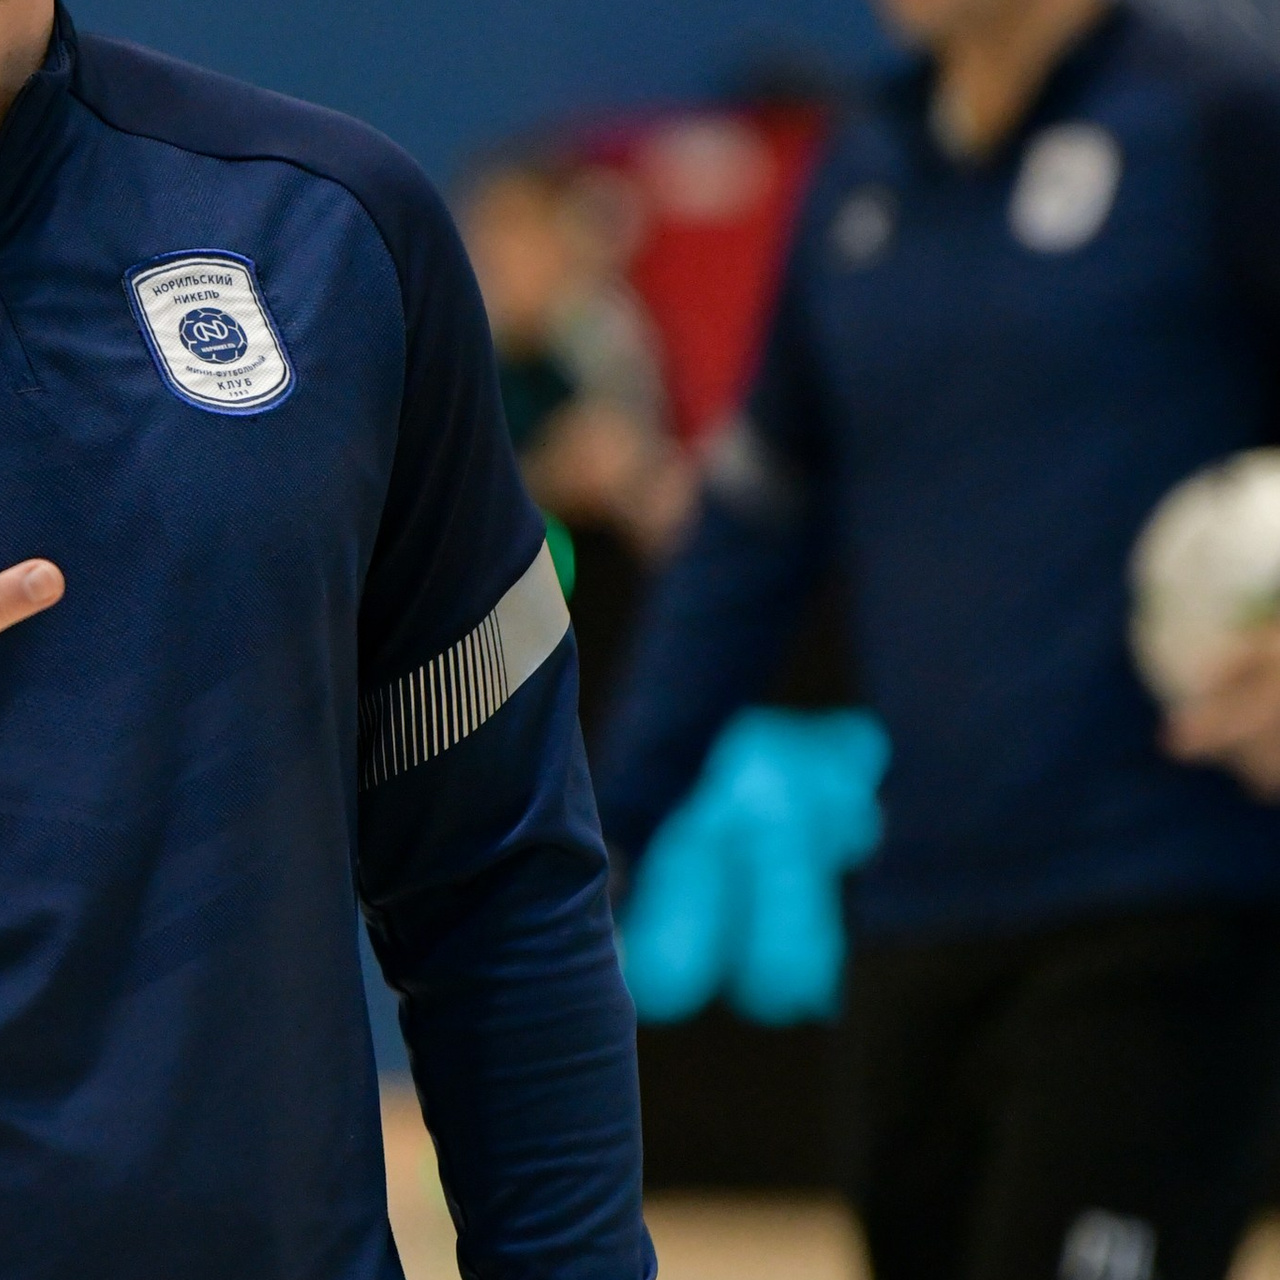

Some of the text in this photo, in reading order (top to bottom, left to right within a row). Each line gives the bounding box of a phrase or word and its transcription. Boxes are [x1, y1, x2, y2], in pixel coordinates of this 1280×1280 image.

[152, 273, 233, 296] НОРИЛЬСКИЙ
[173, 289, 220, 305] НИКЕЛЬ
[185, 354, 266, 377] МИНИ-ФУТБОЛЬНЫЙ
[217, 377, 252, 390] КЛУБ
